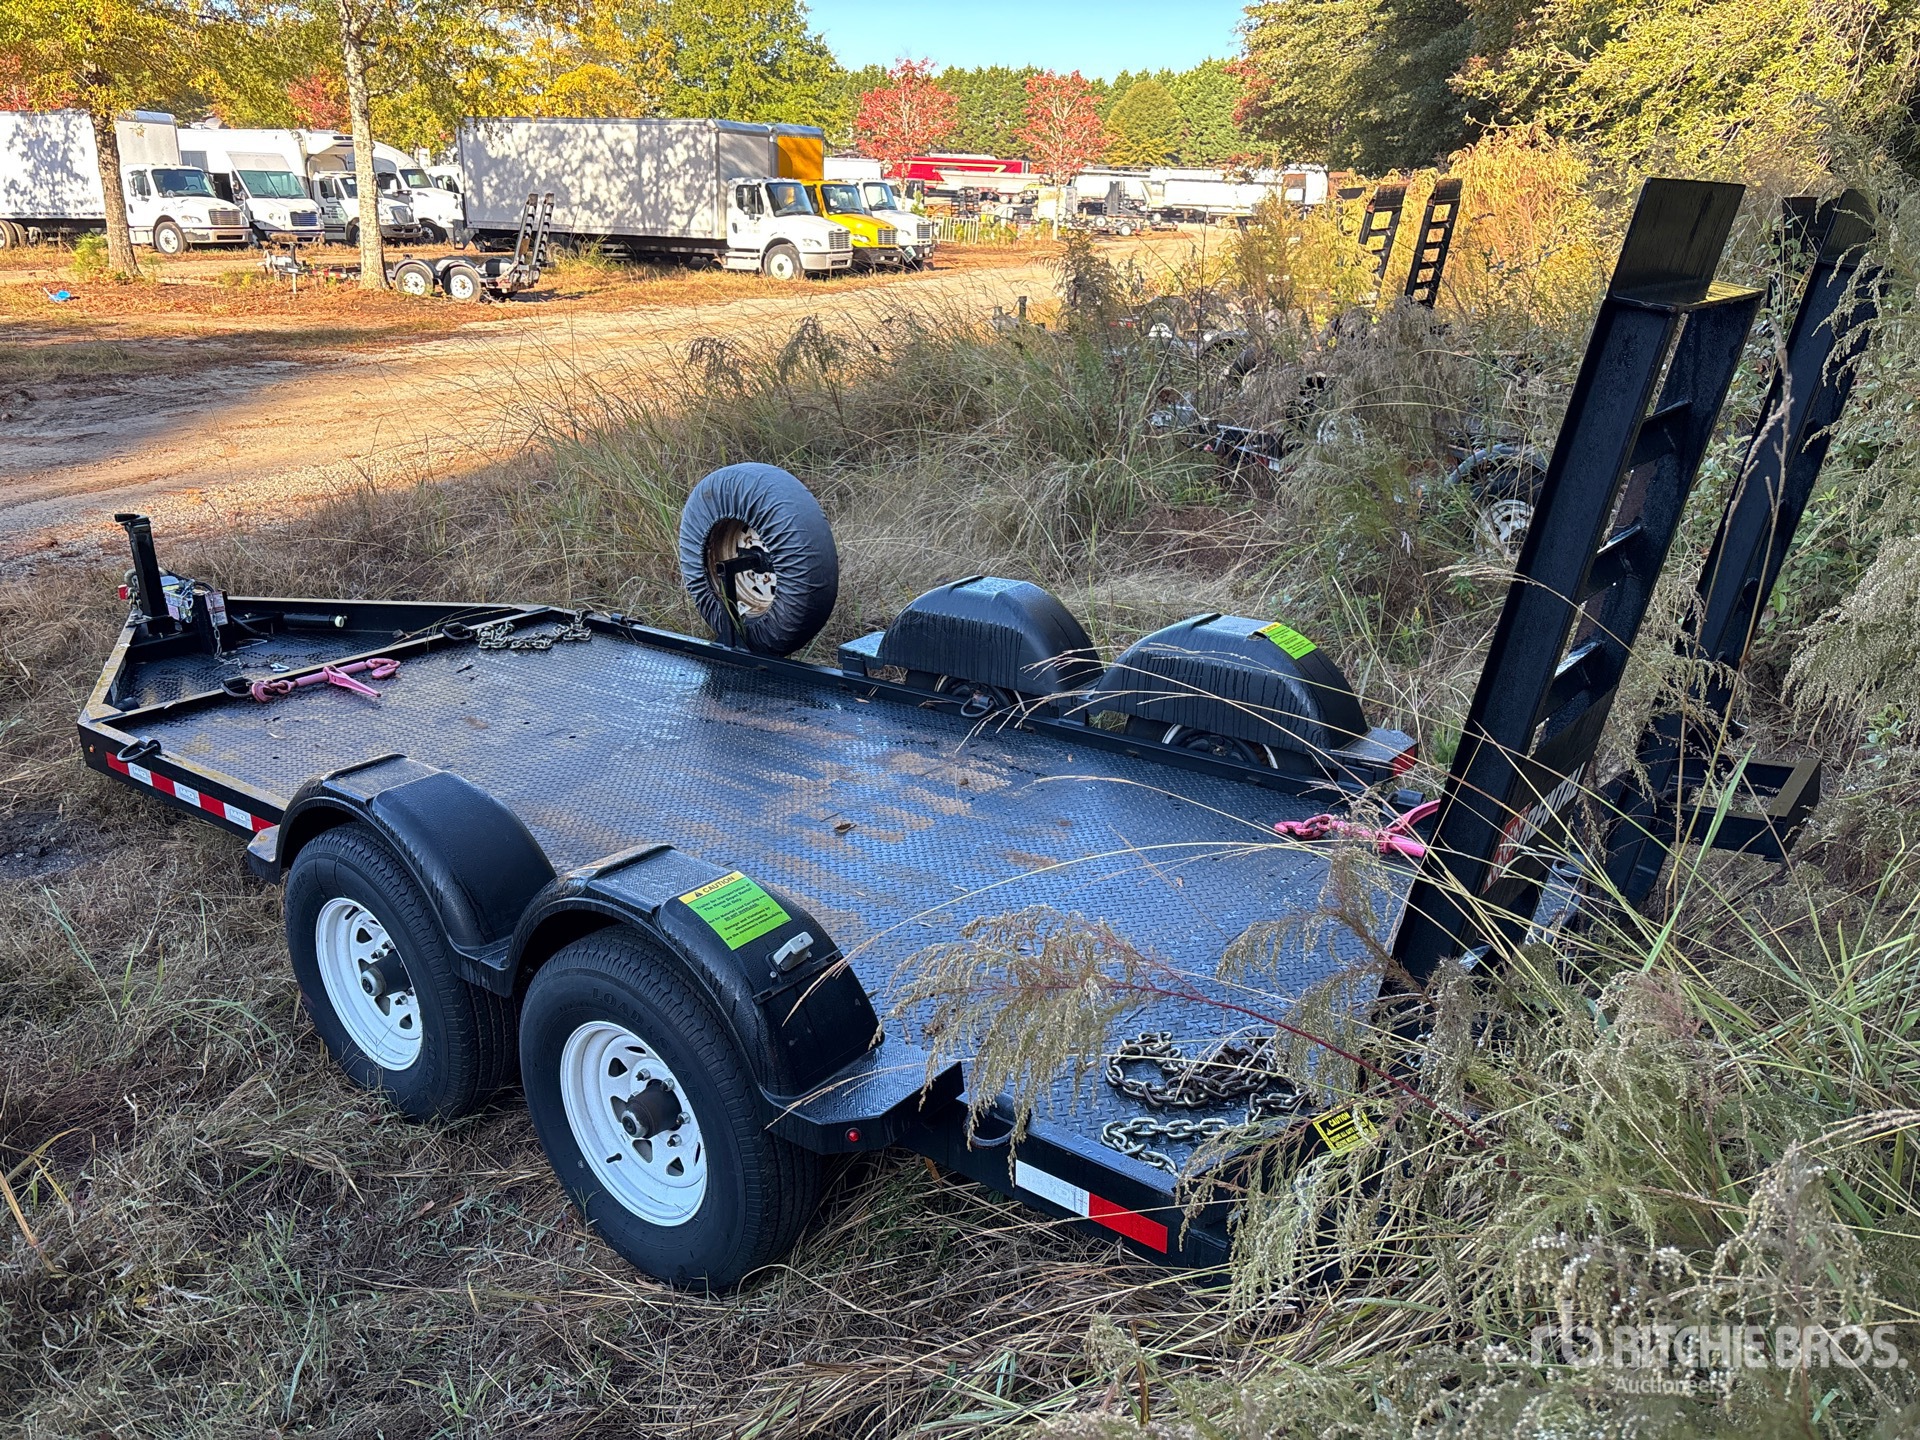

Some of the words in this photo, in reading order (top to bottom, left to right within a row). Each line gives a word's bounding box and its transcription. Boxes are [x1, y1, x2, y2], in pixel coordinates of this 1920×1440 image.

[702, 876, 736, 893] CAUTION
[717, 885, 746, 900] transportation
[592, 987, 644, 1025] LOAD
[656, 1036, 704, 1102] STAR
[1328, 1111, 1351, 1127] CAUTION
